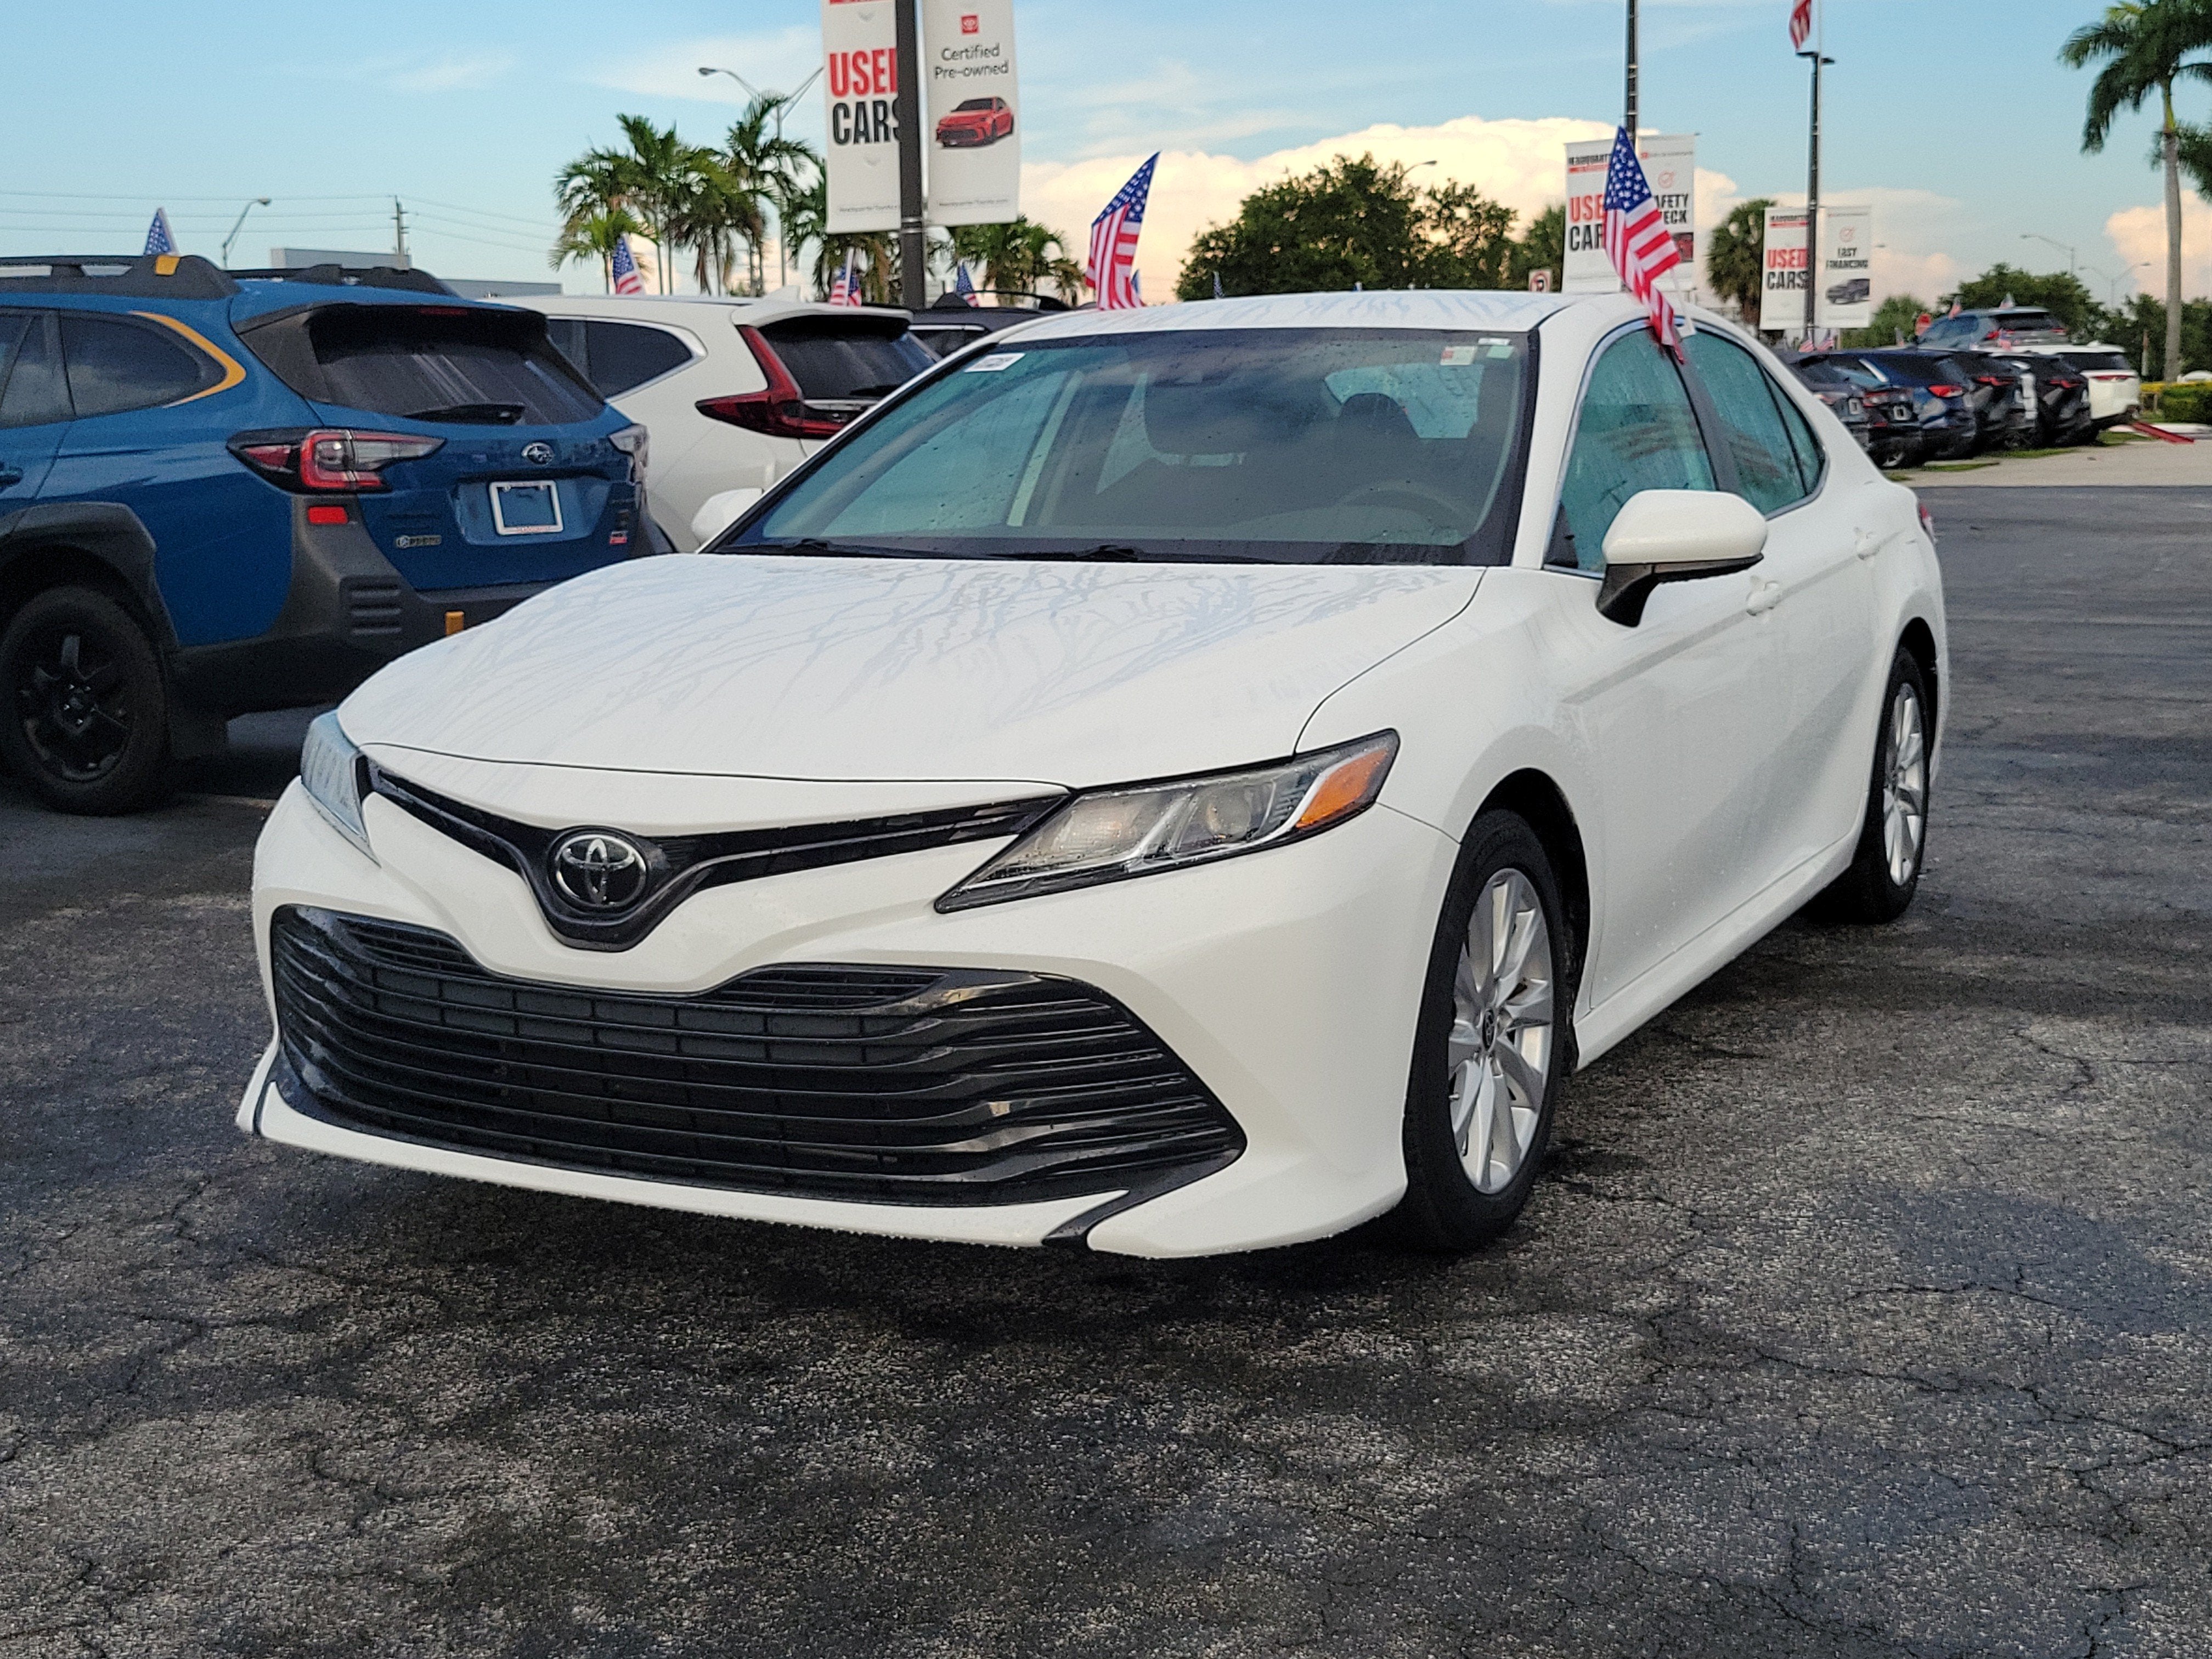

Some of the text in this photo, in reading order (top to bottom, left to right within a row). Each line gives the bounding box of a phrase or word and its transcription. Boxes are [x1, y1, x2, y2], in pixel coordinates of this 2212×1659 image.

[941, 42, 1000, 61] Certified
[935, 59, 1009, 79] Pre-owned
[1570, 194, 1604, 222] USE
[1654, 194, 1688, 208] AFETY
